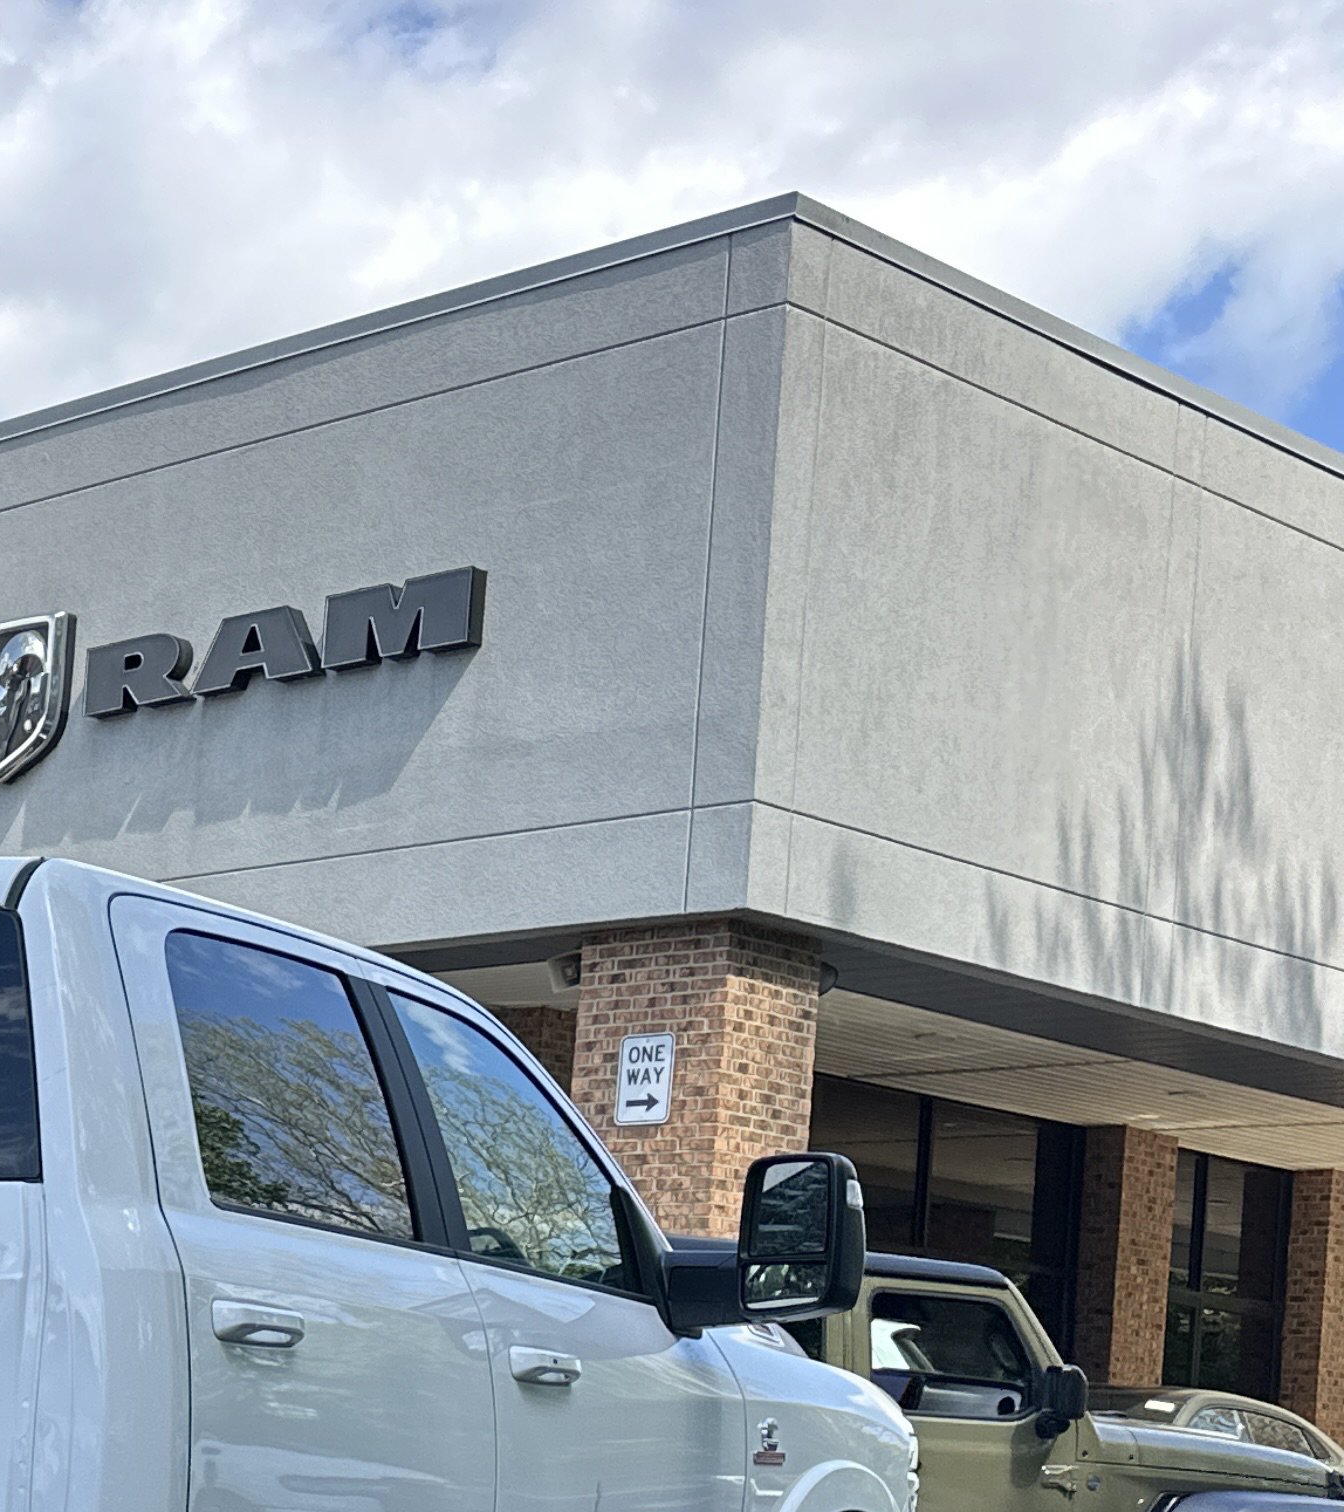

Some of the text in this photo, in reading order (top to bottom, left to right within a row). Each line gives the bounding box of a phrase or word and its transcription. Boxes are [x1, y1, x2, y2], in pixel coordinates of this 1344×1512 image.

[83, 566, 487, 718] RAM
[628, 1044, 666, 1063] ONE
[626, 1066, 665, 1086] WAY
